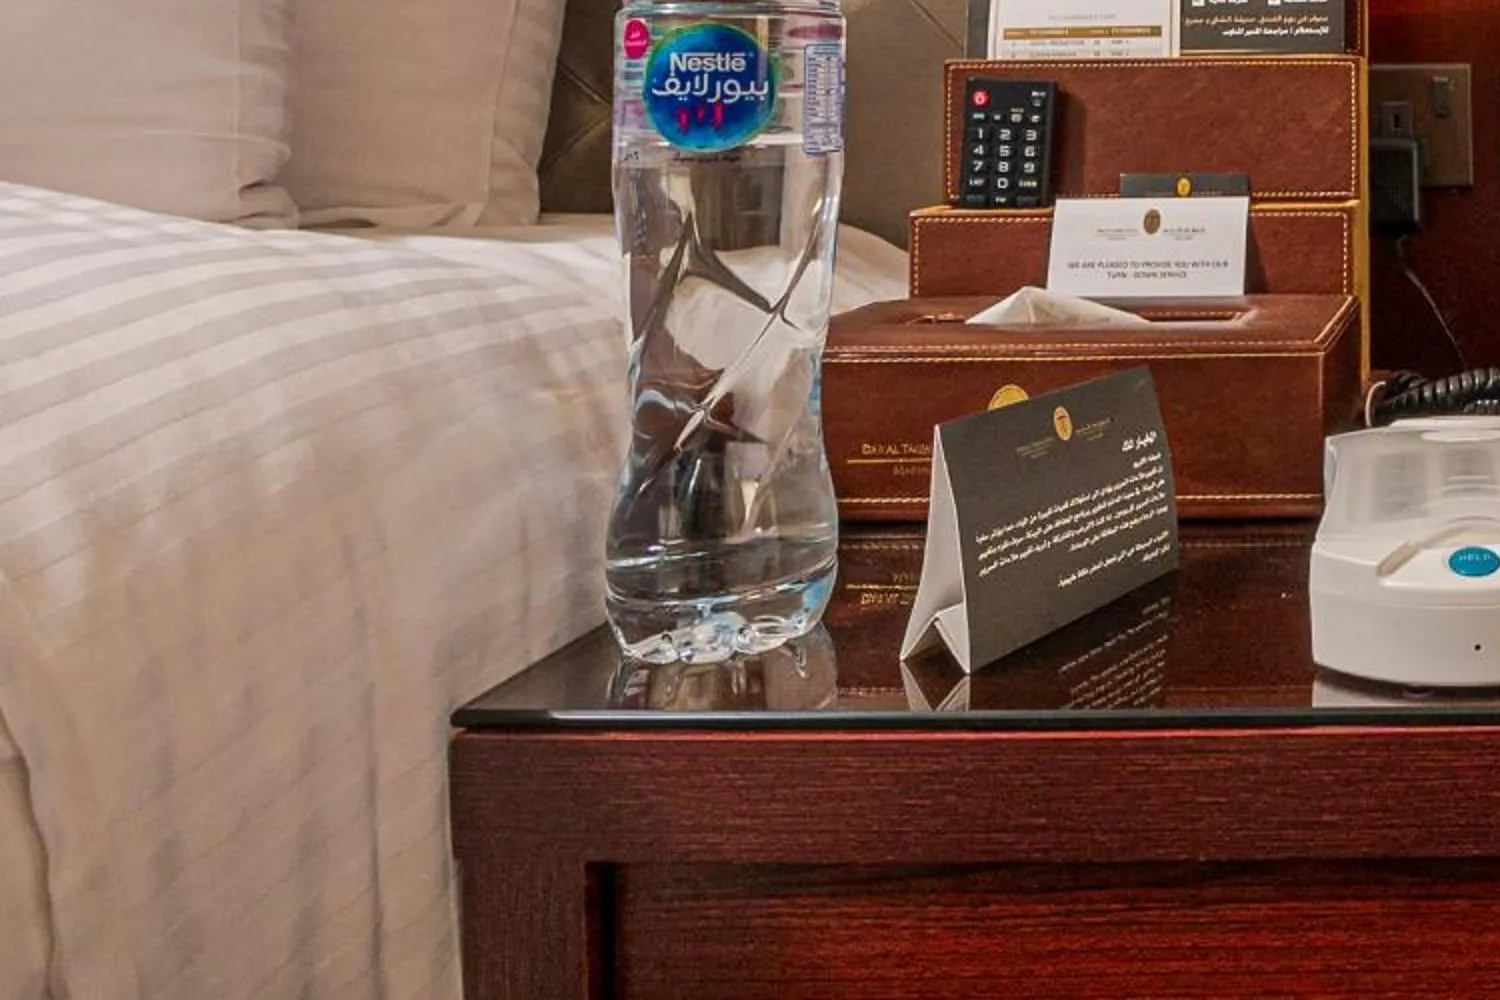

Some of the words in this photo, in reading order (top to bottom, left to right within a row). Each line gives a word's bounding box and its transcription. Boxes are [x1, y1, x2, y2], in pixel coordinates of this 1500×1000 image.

[668, 51, 747, 73] Nestlé
[976, 127, 985, 140] 1
[999, 128, 1012, 141] 2
[1025, 128, 1038, 142] 3
[972, 144, 985, 156] 4
[999, 145, 1011, 158] 5
[1024, 145, 1036, 158] 6
[971, 160, 985, 172] 7
[998, 161, 1010, 173] 8
[1023, 161, 1036, 174] 9
[996, 177, 1010, 190] 0
